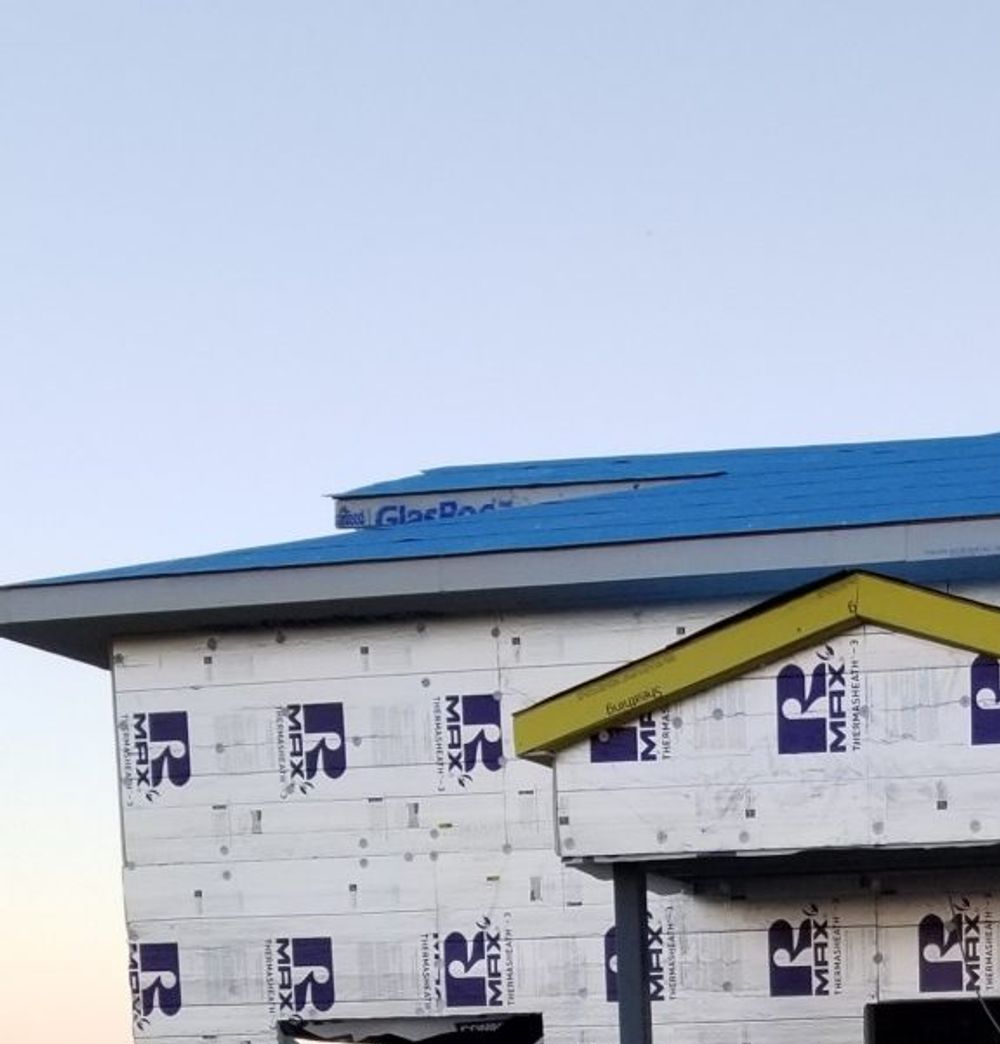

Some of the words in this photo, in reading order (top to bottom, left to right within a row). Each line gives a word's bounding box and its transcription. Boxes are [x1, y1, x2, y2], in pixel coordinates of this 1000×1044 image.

[287, 704, 304, 779] MAX
[445, 695, 463, 771] MAX
[640, 711, 657, 761] MA
[828, 664, 847, 753] MAX
[133, 713, 150, 786] MAX
[276, 938, 293, 1011] MAX
[486, 932, 503, 1007] MAX
[648, 926, 665, 1001] MAX
[813, 919, 829, 996] MAX
[964, 914, 980, 991] MAX
